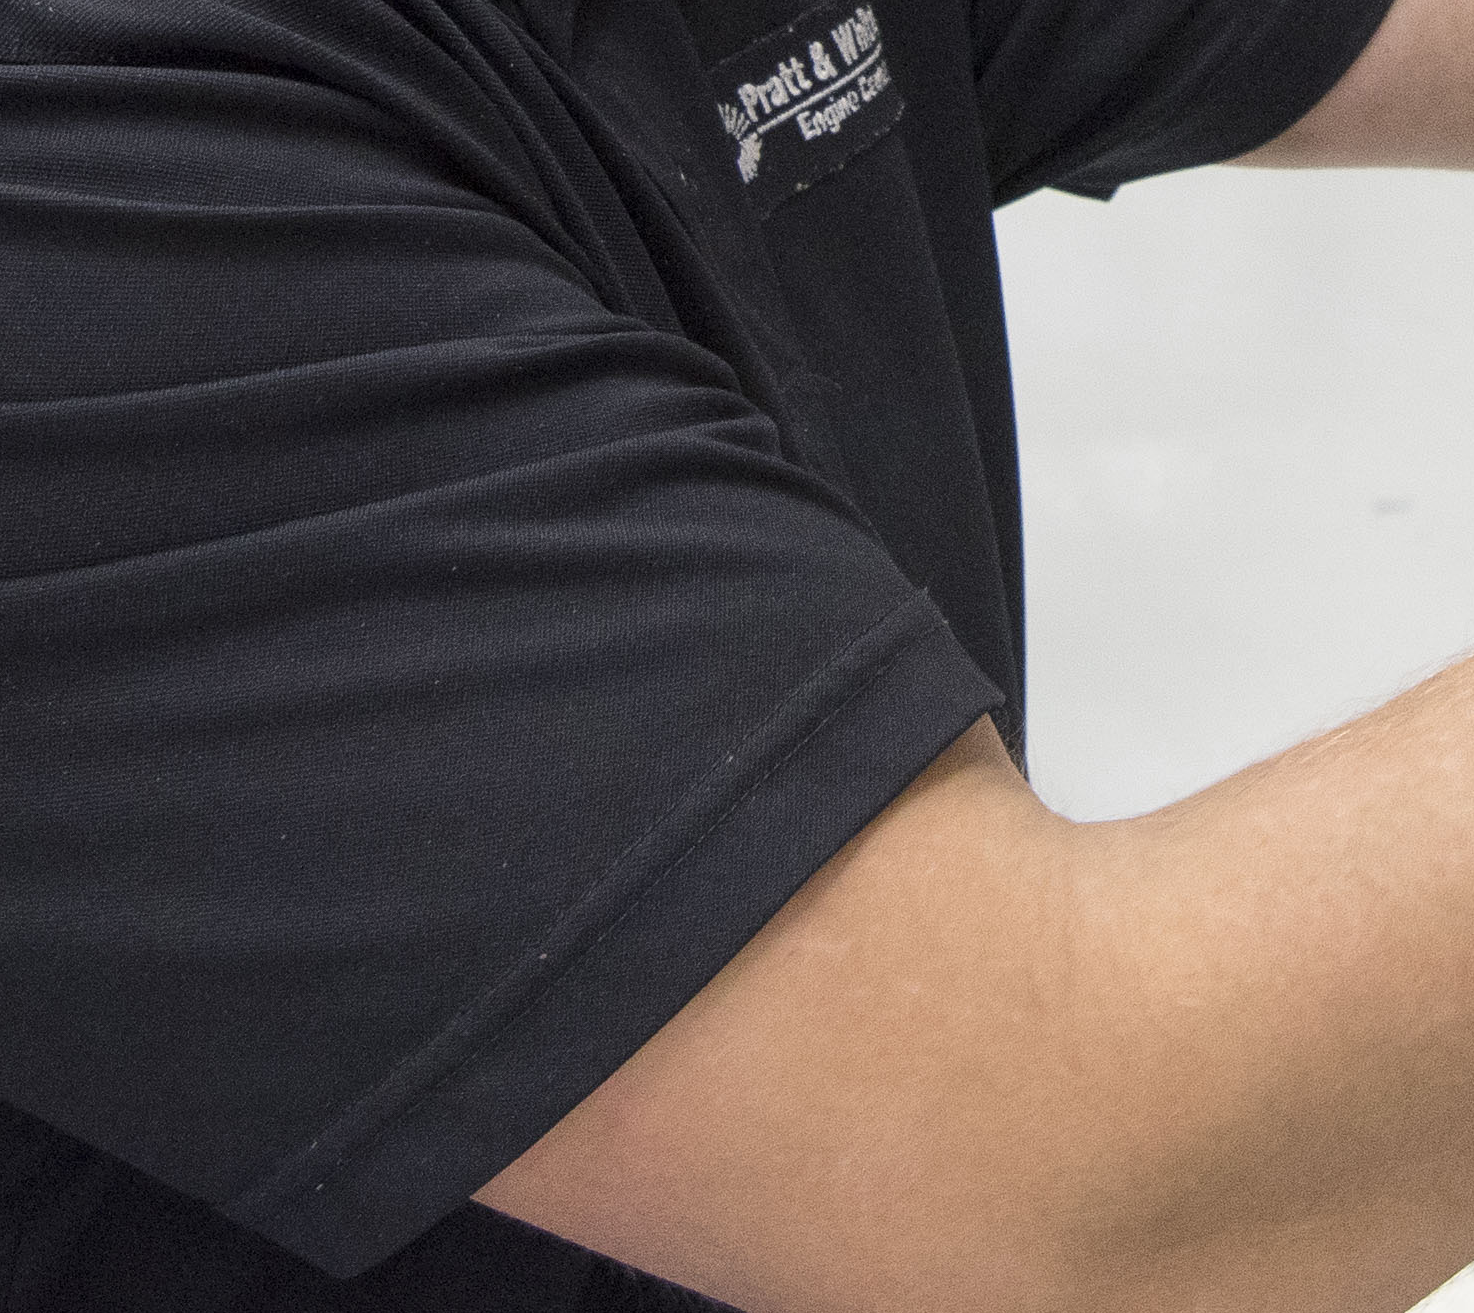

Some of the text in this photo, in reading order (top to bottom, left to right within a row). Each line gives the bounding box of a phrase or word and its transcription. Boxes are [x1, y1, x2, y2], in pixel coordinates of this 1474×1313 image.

[737, 57, 813, 122] Pratt
[809, 41, 838, 80] &
[796, 90, 861, 141] Engine
